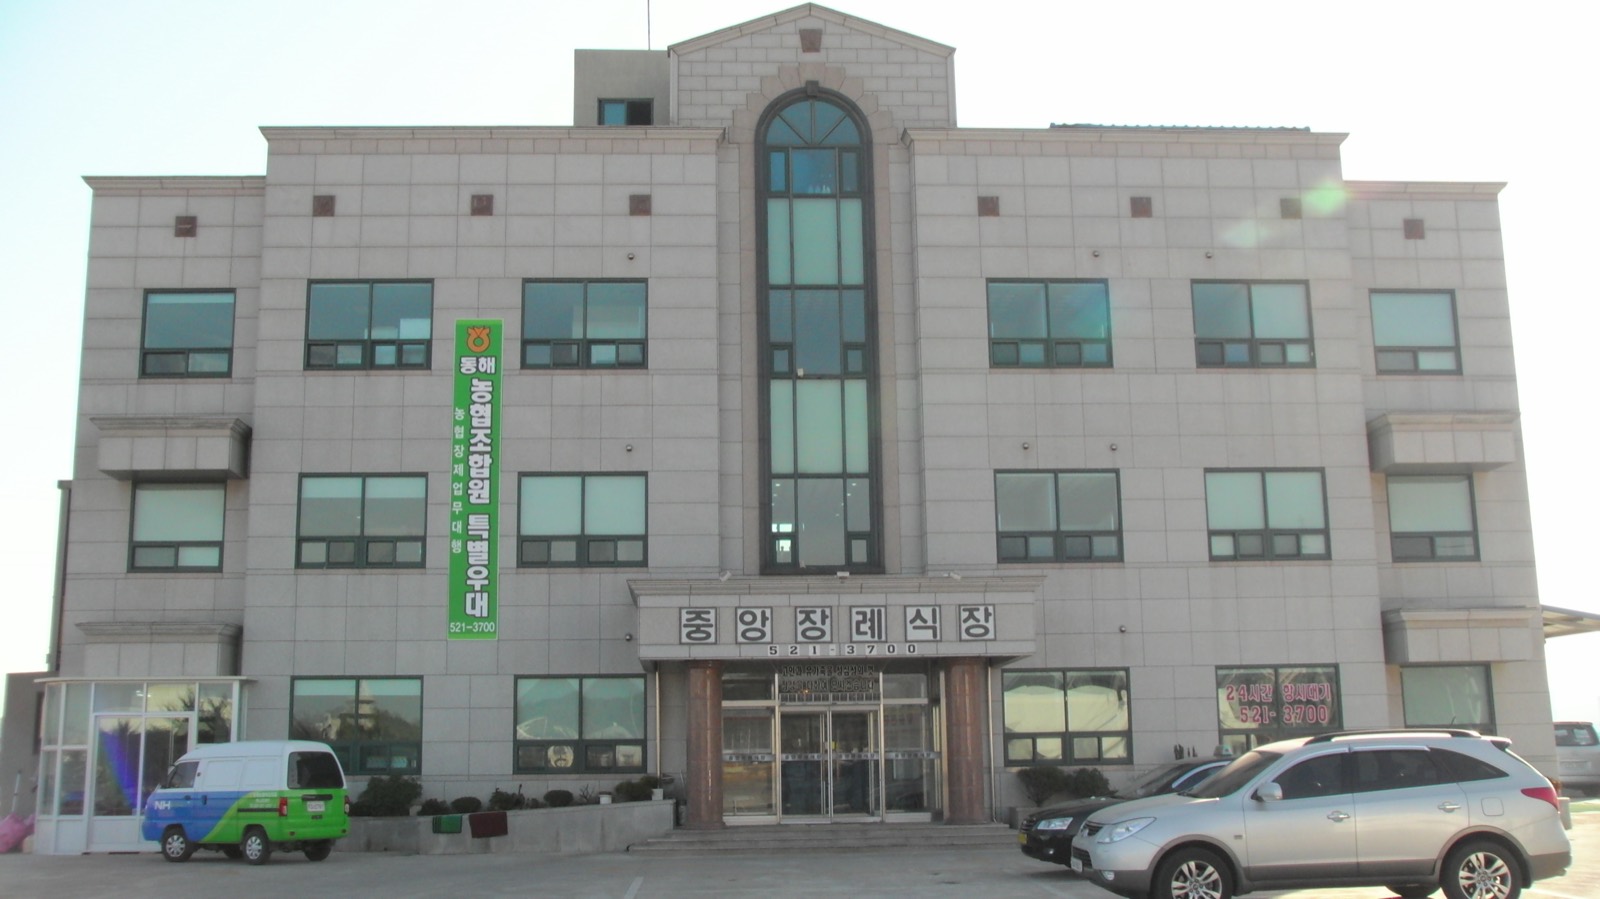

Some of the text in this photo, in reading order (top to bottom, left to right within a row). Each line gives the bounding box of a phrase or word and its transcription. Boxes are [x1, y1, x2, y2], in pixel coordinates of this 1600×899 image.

[459, 356, 497, 375] 동해
[464, 377, 494, 618] 농협조합원 특별우대
[449, 621, 496, 633] 521-3700
[683, 606, 992, 642] 중앙장례식장
[1225, 683, 1332, 703] 24시간 항시대기
[154, 800, 171, 810] NH
